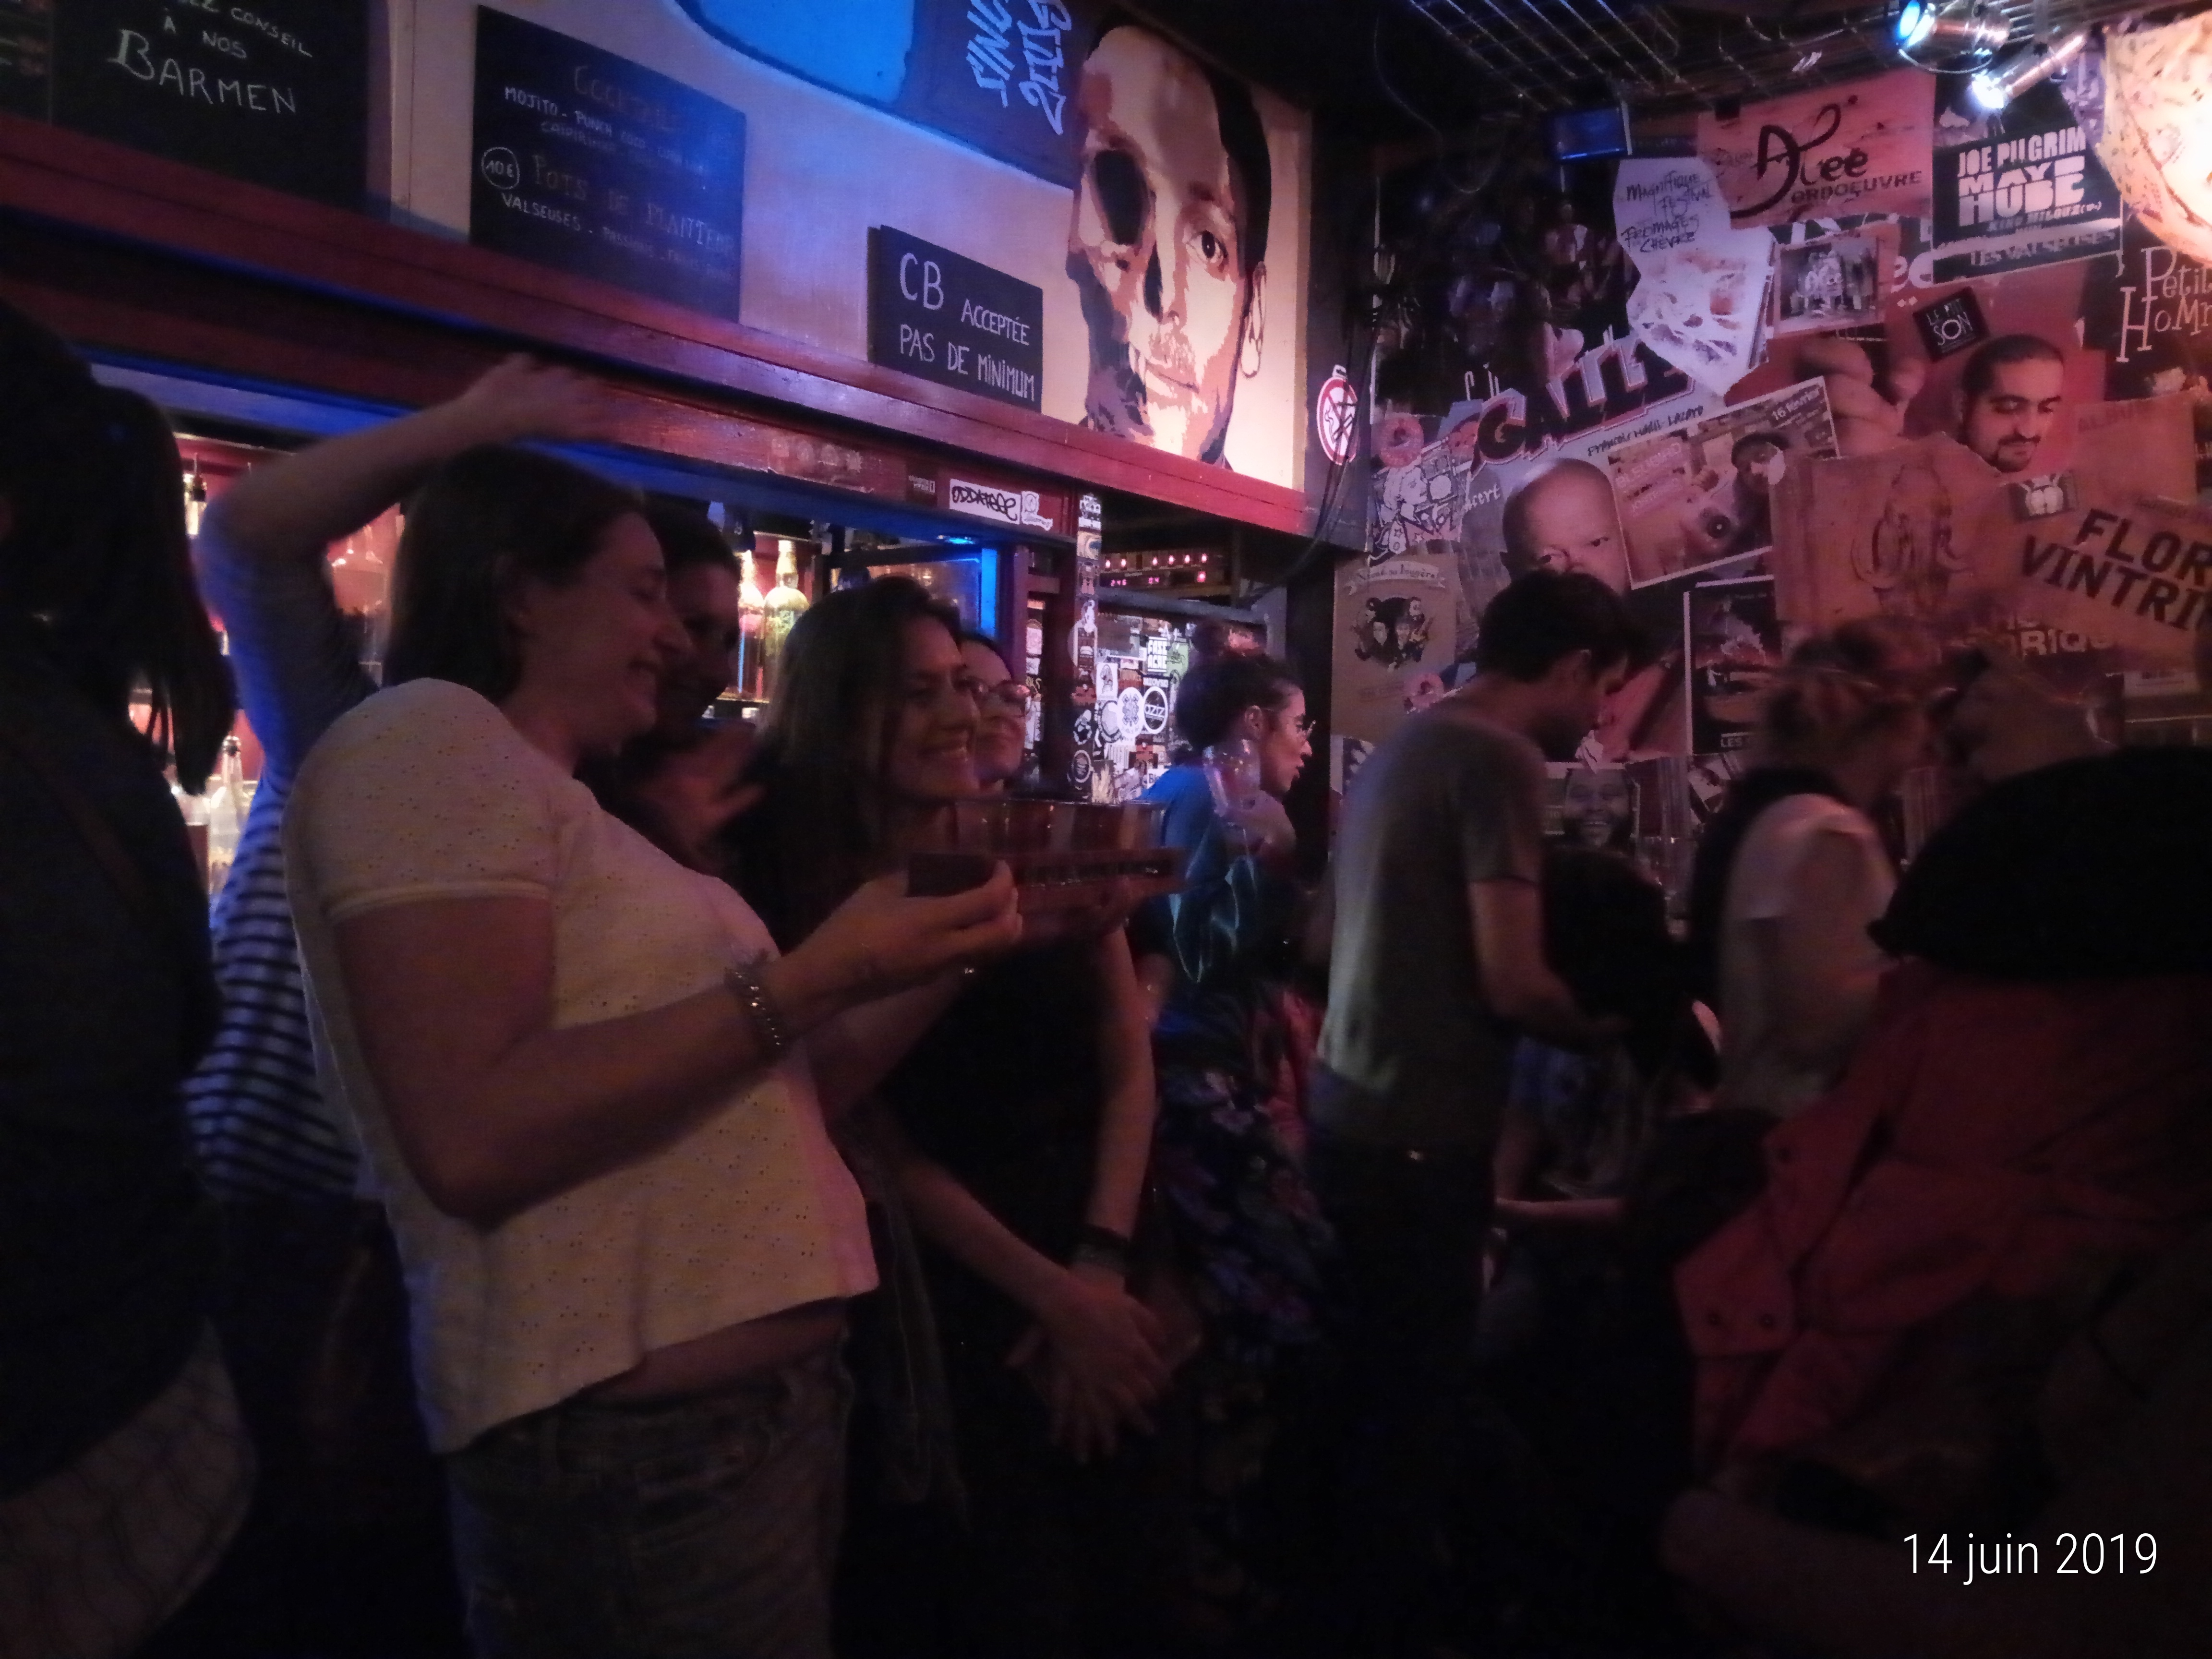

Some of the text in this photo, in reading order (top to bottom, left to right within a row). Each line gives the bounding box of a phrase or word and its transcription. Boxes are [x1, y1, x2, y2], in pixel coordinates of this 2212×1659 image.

[202, 30, 247, 59] NOS
[231, 8, 313, 58] CONSEIL
[107, 29, 296, 114] BARMEN
[1958, 127, 2087, 177] JOE PILGRIM
[502, 192, 581, 232] VALSEUSES
[900, 252, 1031, 346] CB ACCEPTÉE
[900, 324, 936, 363] PAS
[947, 341, 970, 375] DE
[1933, 311, 1973, 346] SON
